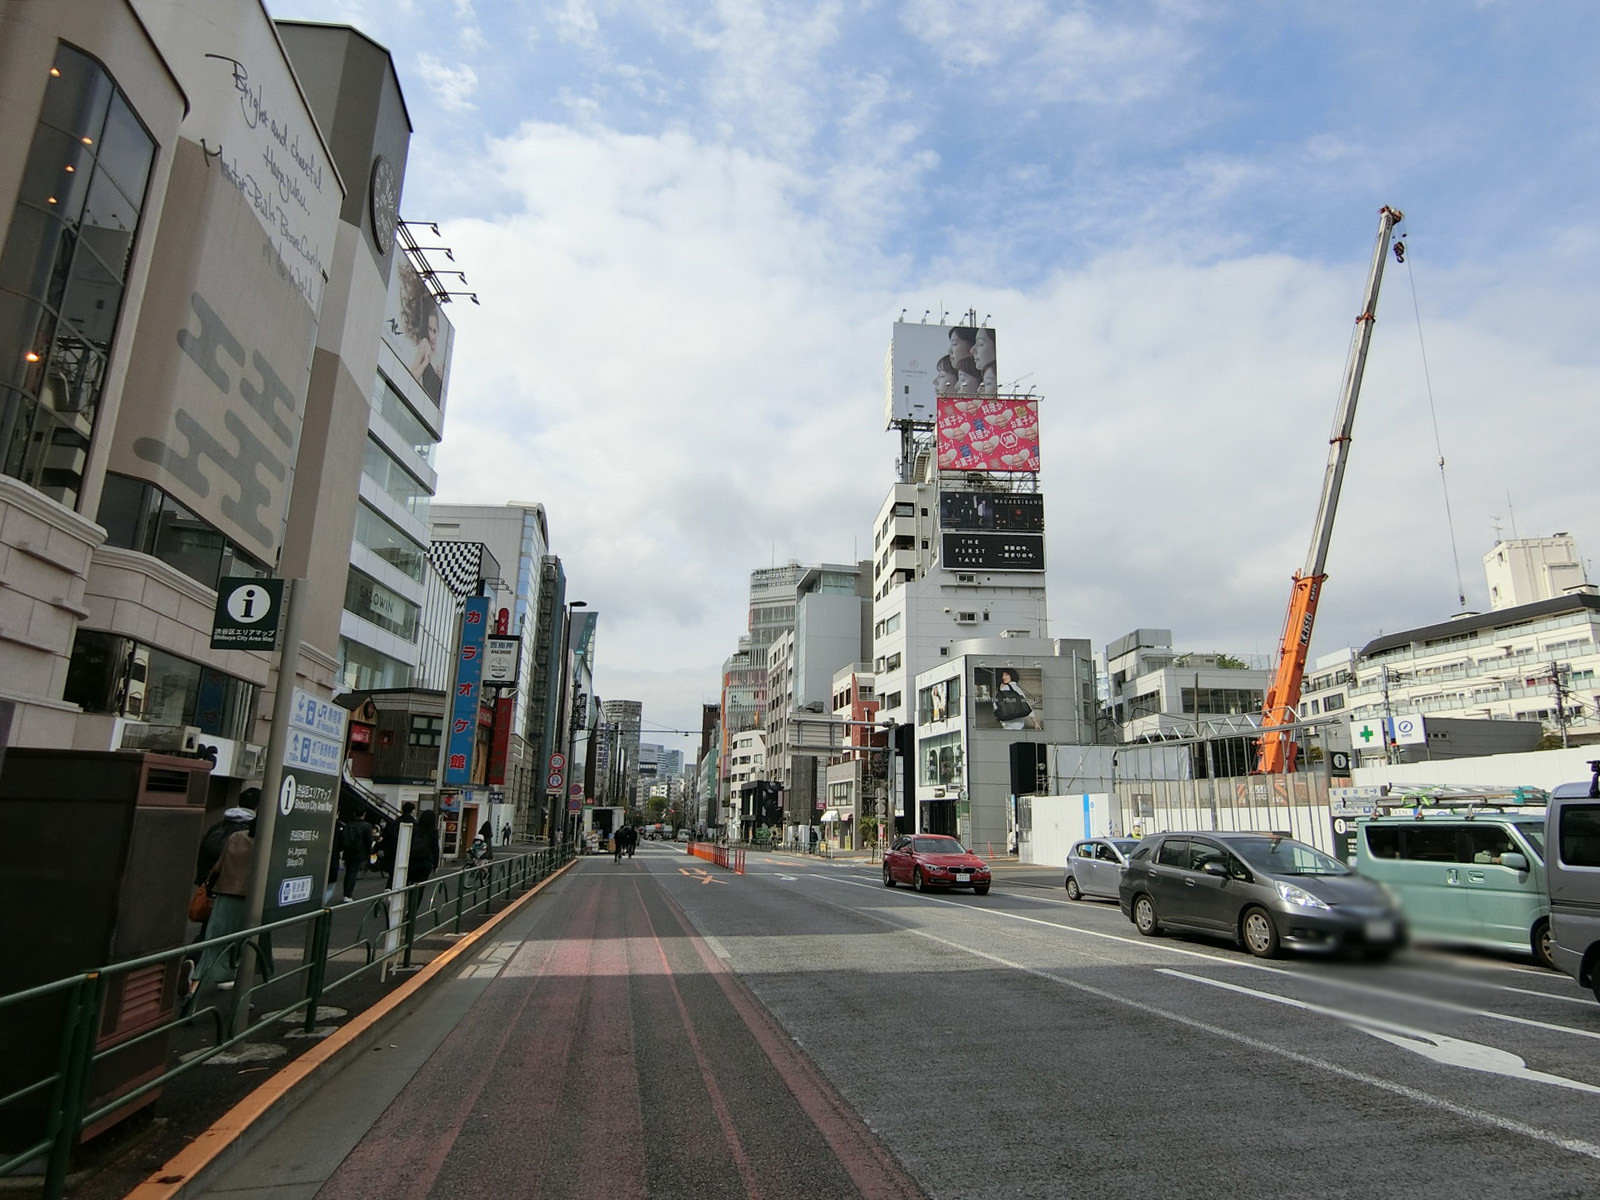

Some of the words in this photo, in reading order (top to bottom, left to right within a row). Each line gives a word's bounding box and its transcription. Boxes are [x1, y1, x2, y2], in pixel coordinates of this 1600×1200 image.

[205, 53, 269, 129] Bright
[270, 119, 288, 152] and
[982, 401, 1008, 416] 料理か?
[938, 412, 968, 428] お菓子か?
[968, 425, 996, 441] 料理か?
[955, 452, 984, 468] お菓子か?
[213, 627, 276, 637] 渋谷区エリアマップ
[1300, 612, 1313, 646] KAISEI
[213, 634, 236, 642] Shibuya
[236, 635, 249, 643] City
[449, 610, 482, 770] カラオケ館
[318, 704, 328, 720] JR
[552, 757, 562, 765] 50
[294, 798, 310, 812] Shibuya
[317, 801, 326, 811] Area
[325, 802, 333, 813] Map
